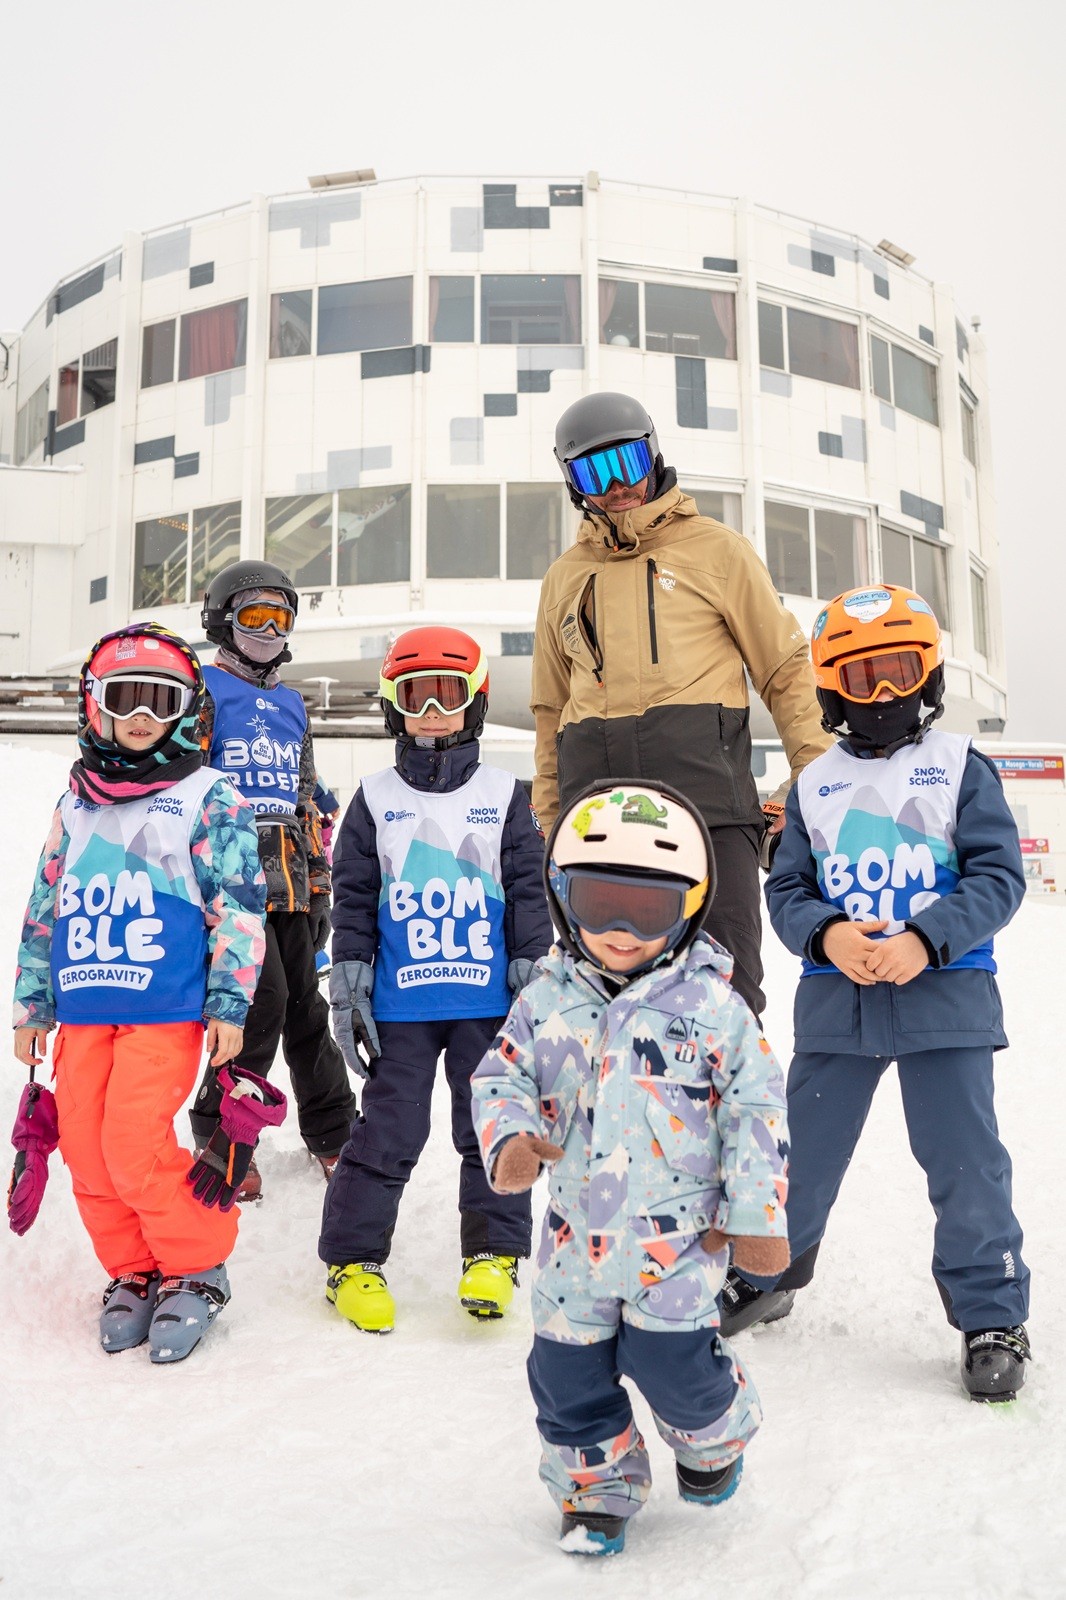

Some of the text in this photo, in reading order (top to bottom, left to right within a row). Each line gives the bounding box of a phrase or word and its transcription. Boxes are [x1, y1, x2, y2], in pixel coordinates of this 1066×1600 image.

[914, 767, 946, 777] SNOW
[909, 776, 950, 786] SCHOOL
[153, 797, 184, 806] SNOW
[147, 804, 184, 817] SCHOOL
[469, 807, 499, 816] SNOW
[823, 842, 936, 899] BOM
[59, 870, 155, 917] BOM
[388, 876, 488, 922] BOM
[67, 915, 166, 962] BLE
[407, 917, 494, 961] BLE
[61, 969, 147, 986] ZEROGRAVITY
[400, 966, 487, 984] ZEROGRAVITY
